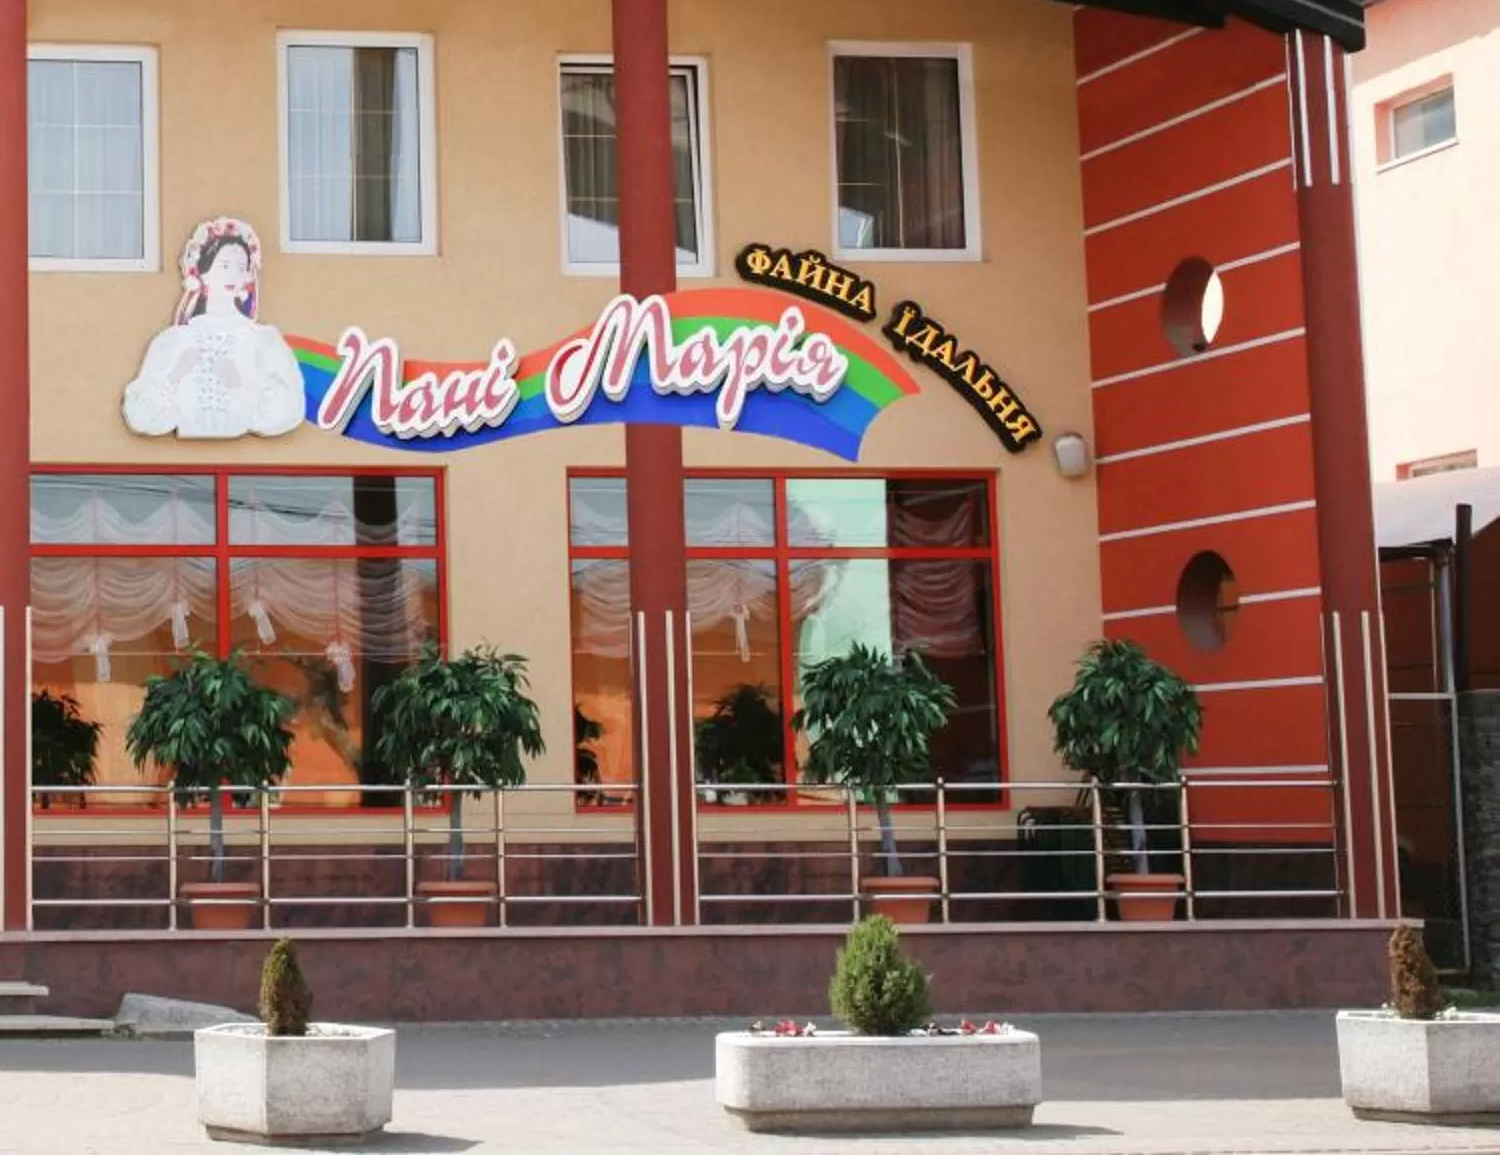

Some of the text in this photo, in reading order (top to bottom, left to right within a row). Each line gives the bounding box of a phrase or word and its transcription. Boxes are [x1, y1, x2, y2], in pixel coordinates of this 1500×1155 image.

[319, 294, 849, 433] Пані Марія
[746, 247, 1037, 443] ФАЙНА ЇДАЛЬНЯ
